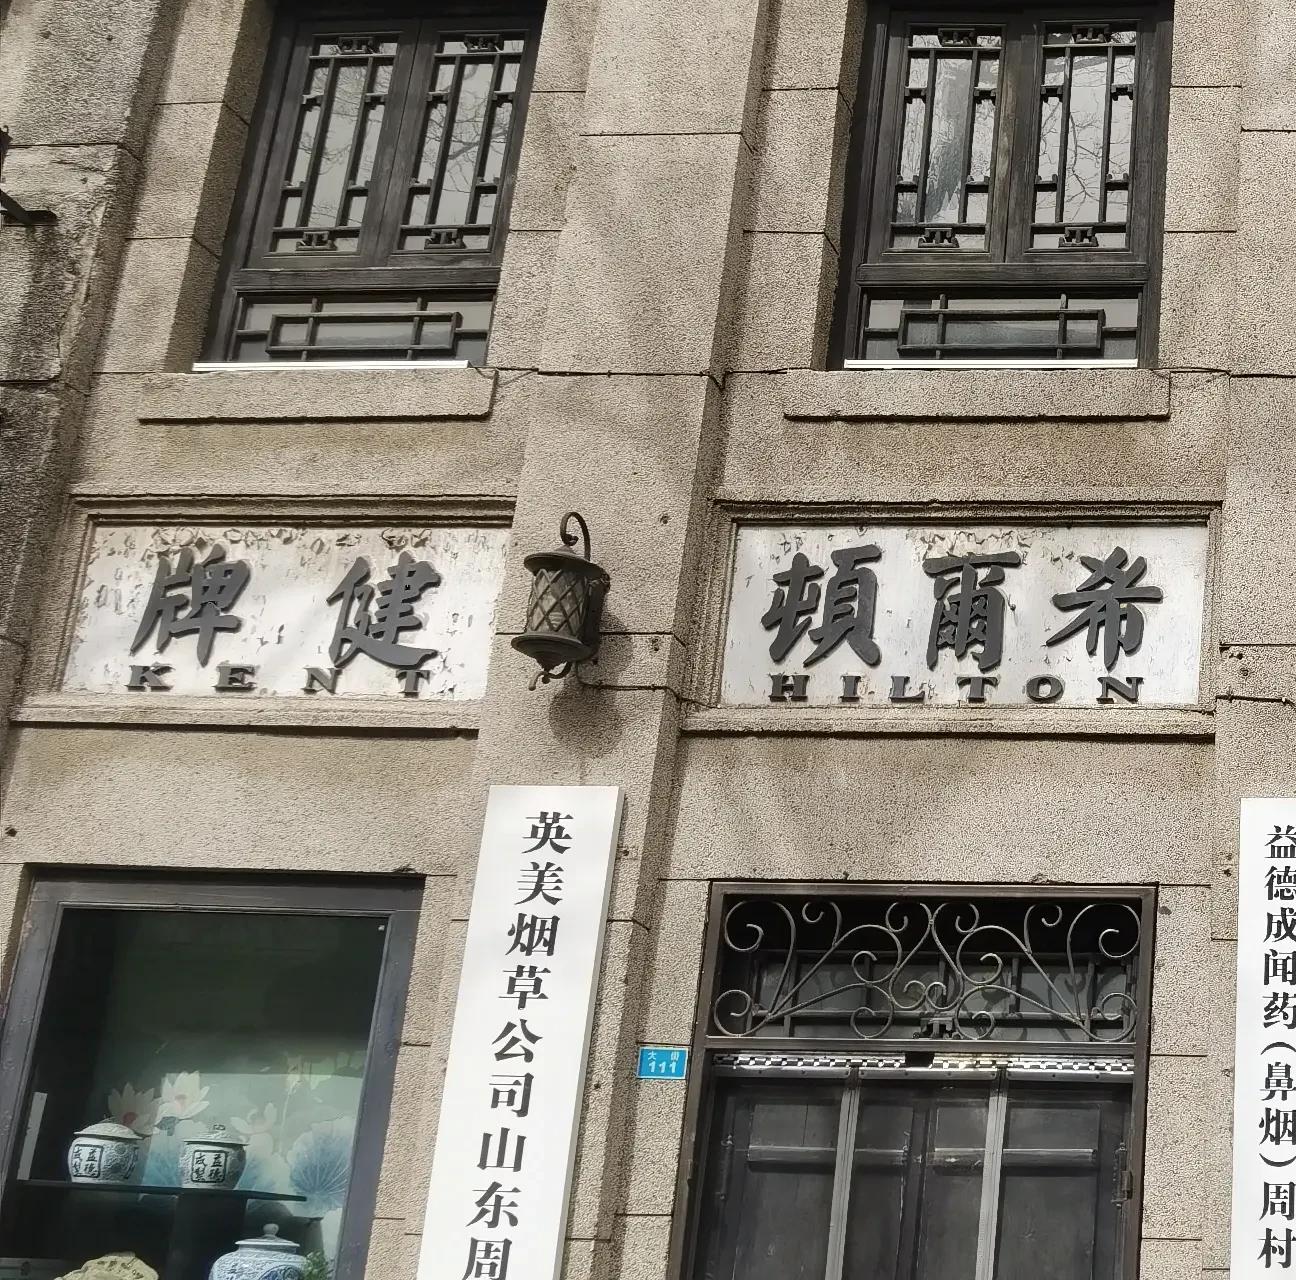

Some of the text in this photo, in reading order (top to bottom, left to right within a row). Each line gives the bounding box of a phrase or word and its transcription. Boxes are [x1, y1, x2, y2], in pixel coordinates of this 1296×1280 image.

[125, 664, 430, 695] KENT
[768, 674, 1143, 703] HILTON
[648, 1061, 677, 1074] 111
